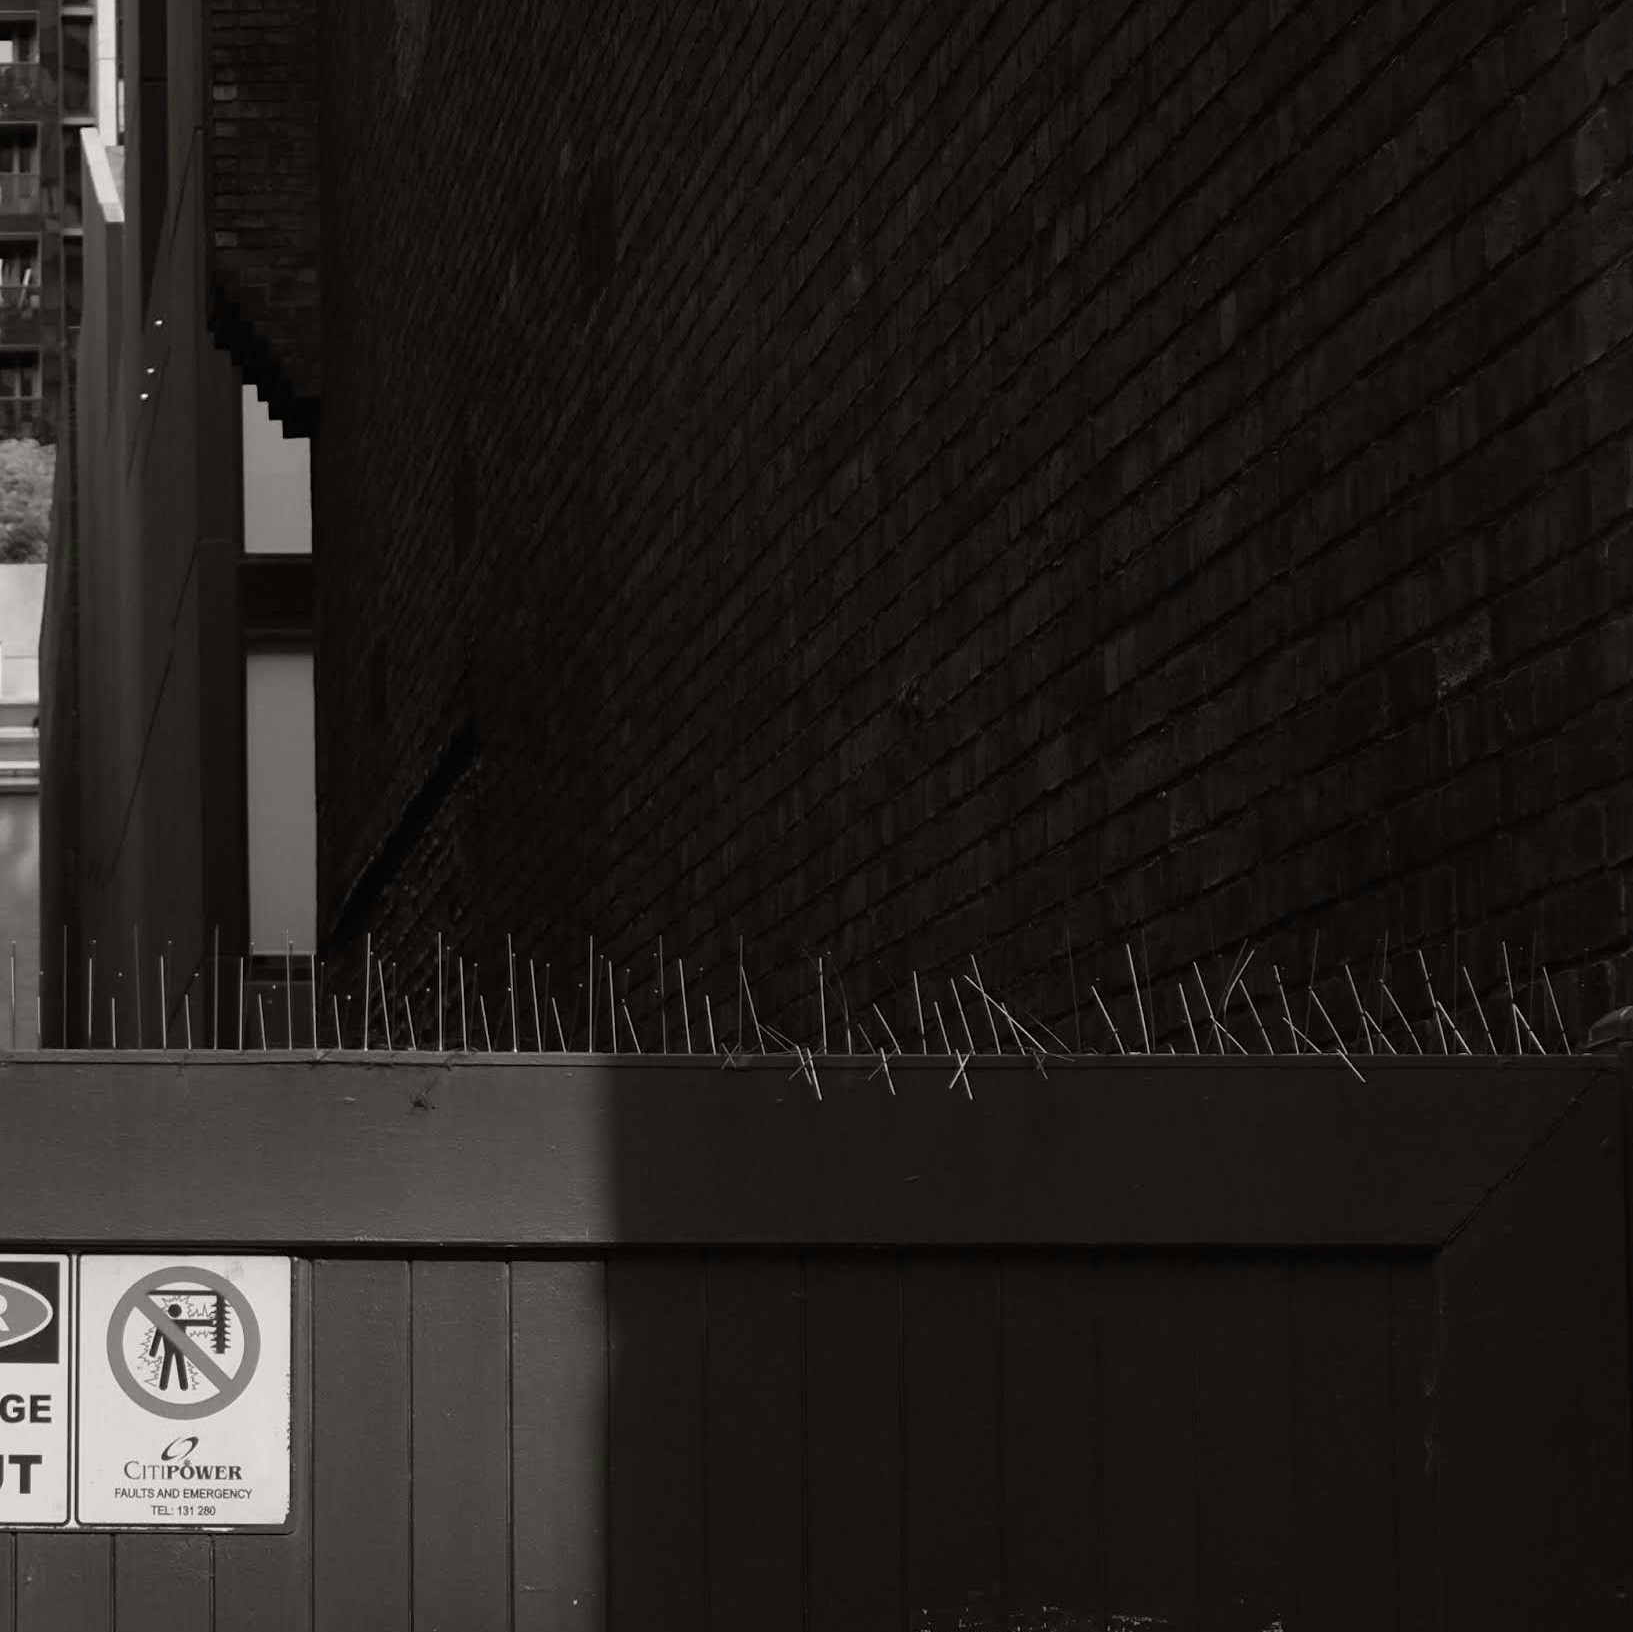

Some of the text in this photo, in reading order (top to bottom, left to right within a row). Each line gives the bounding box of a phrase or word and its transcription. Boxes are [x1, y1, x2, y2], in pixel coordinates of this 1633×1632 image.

[114, 1487, 253, 1499] FAULTS AND EMERGENCY
[151, 1505, 216, 1516] TEL: 131 280
